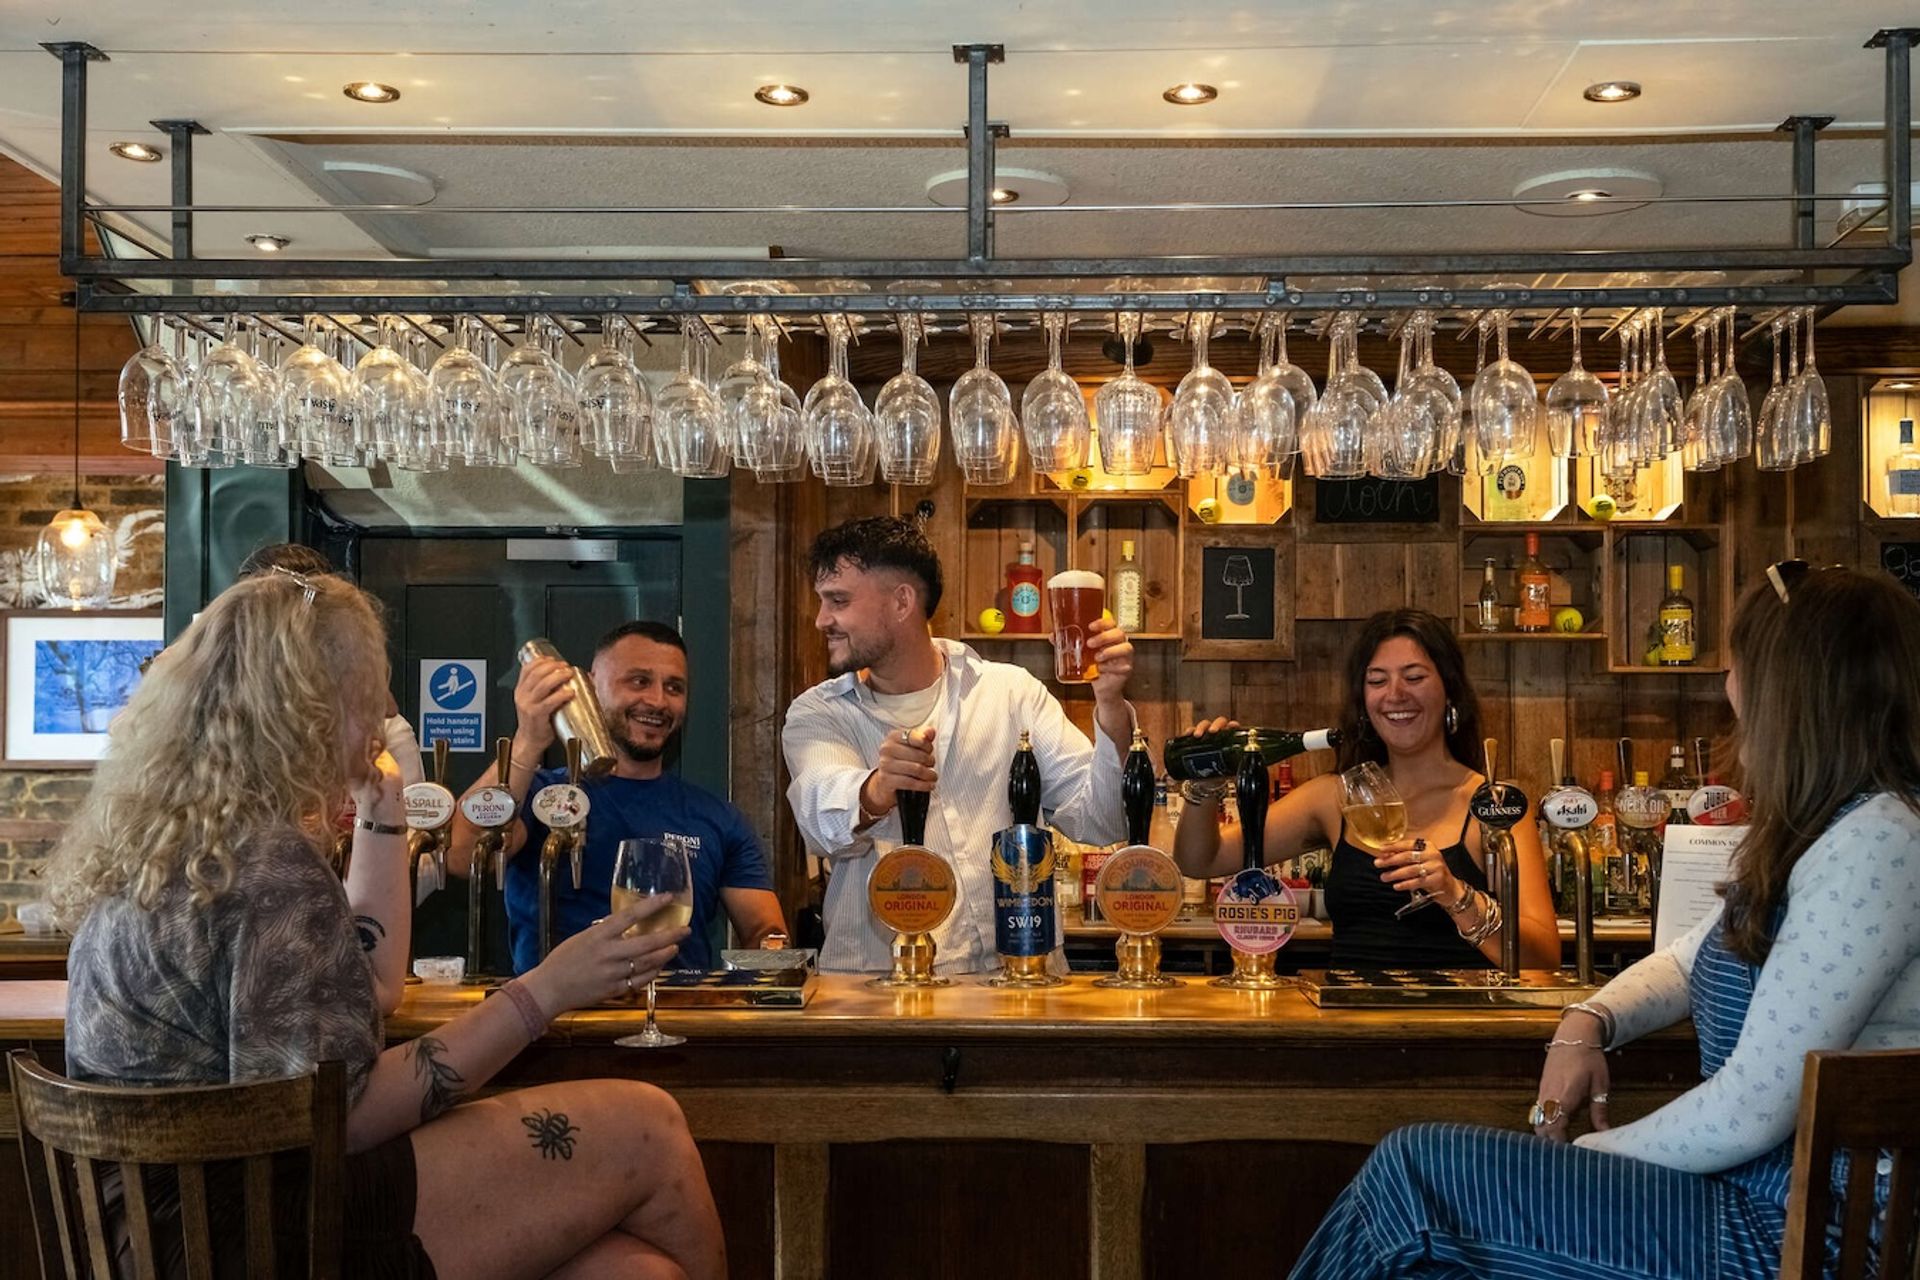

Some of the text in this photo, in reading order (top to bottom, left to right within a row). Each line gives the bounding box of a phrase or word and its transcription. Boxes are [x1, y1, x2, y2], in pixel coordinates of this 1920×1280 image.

[426, 717, 480, 725] Hold handrail
[430, 727, 475, 736] when using
[472, 804, 505, 812] PERONI
[1478, 804, 1521, 816] GUINNESS
[1557, 803, 1587, 816] Asahi
[1619, 800, 1666, 814] NECK OIL
[1689, 839, 1727, 847] COMMON
[884, 901, 940, 911] ORIGINAL
[1112, 901, 1169, 911] ORIGINAL
[1219, 907, 1296, 920] ROSIE'S PIG
[1008, 915, 1042, 929] SW19
